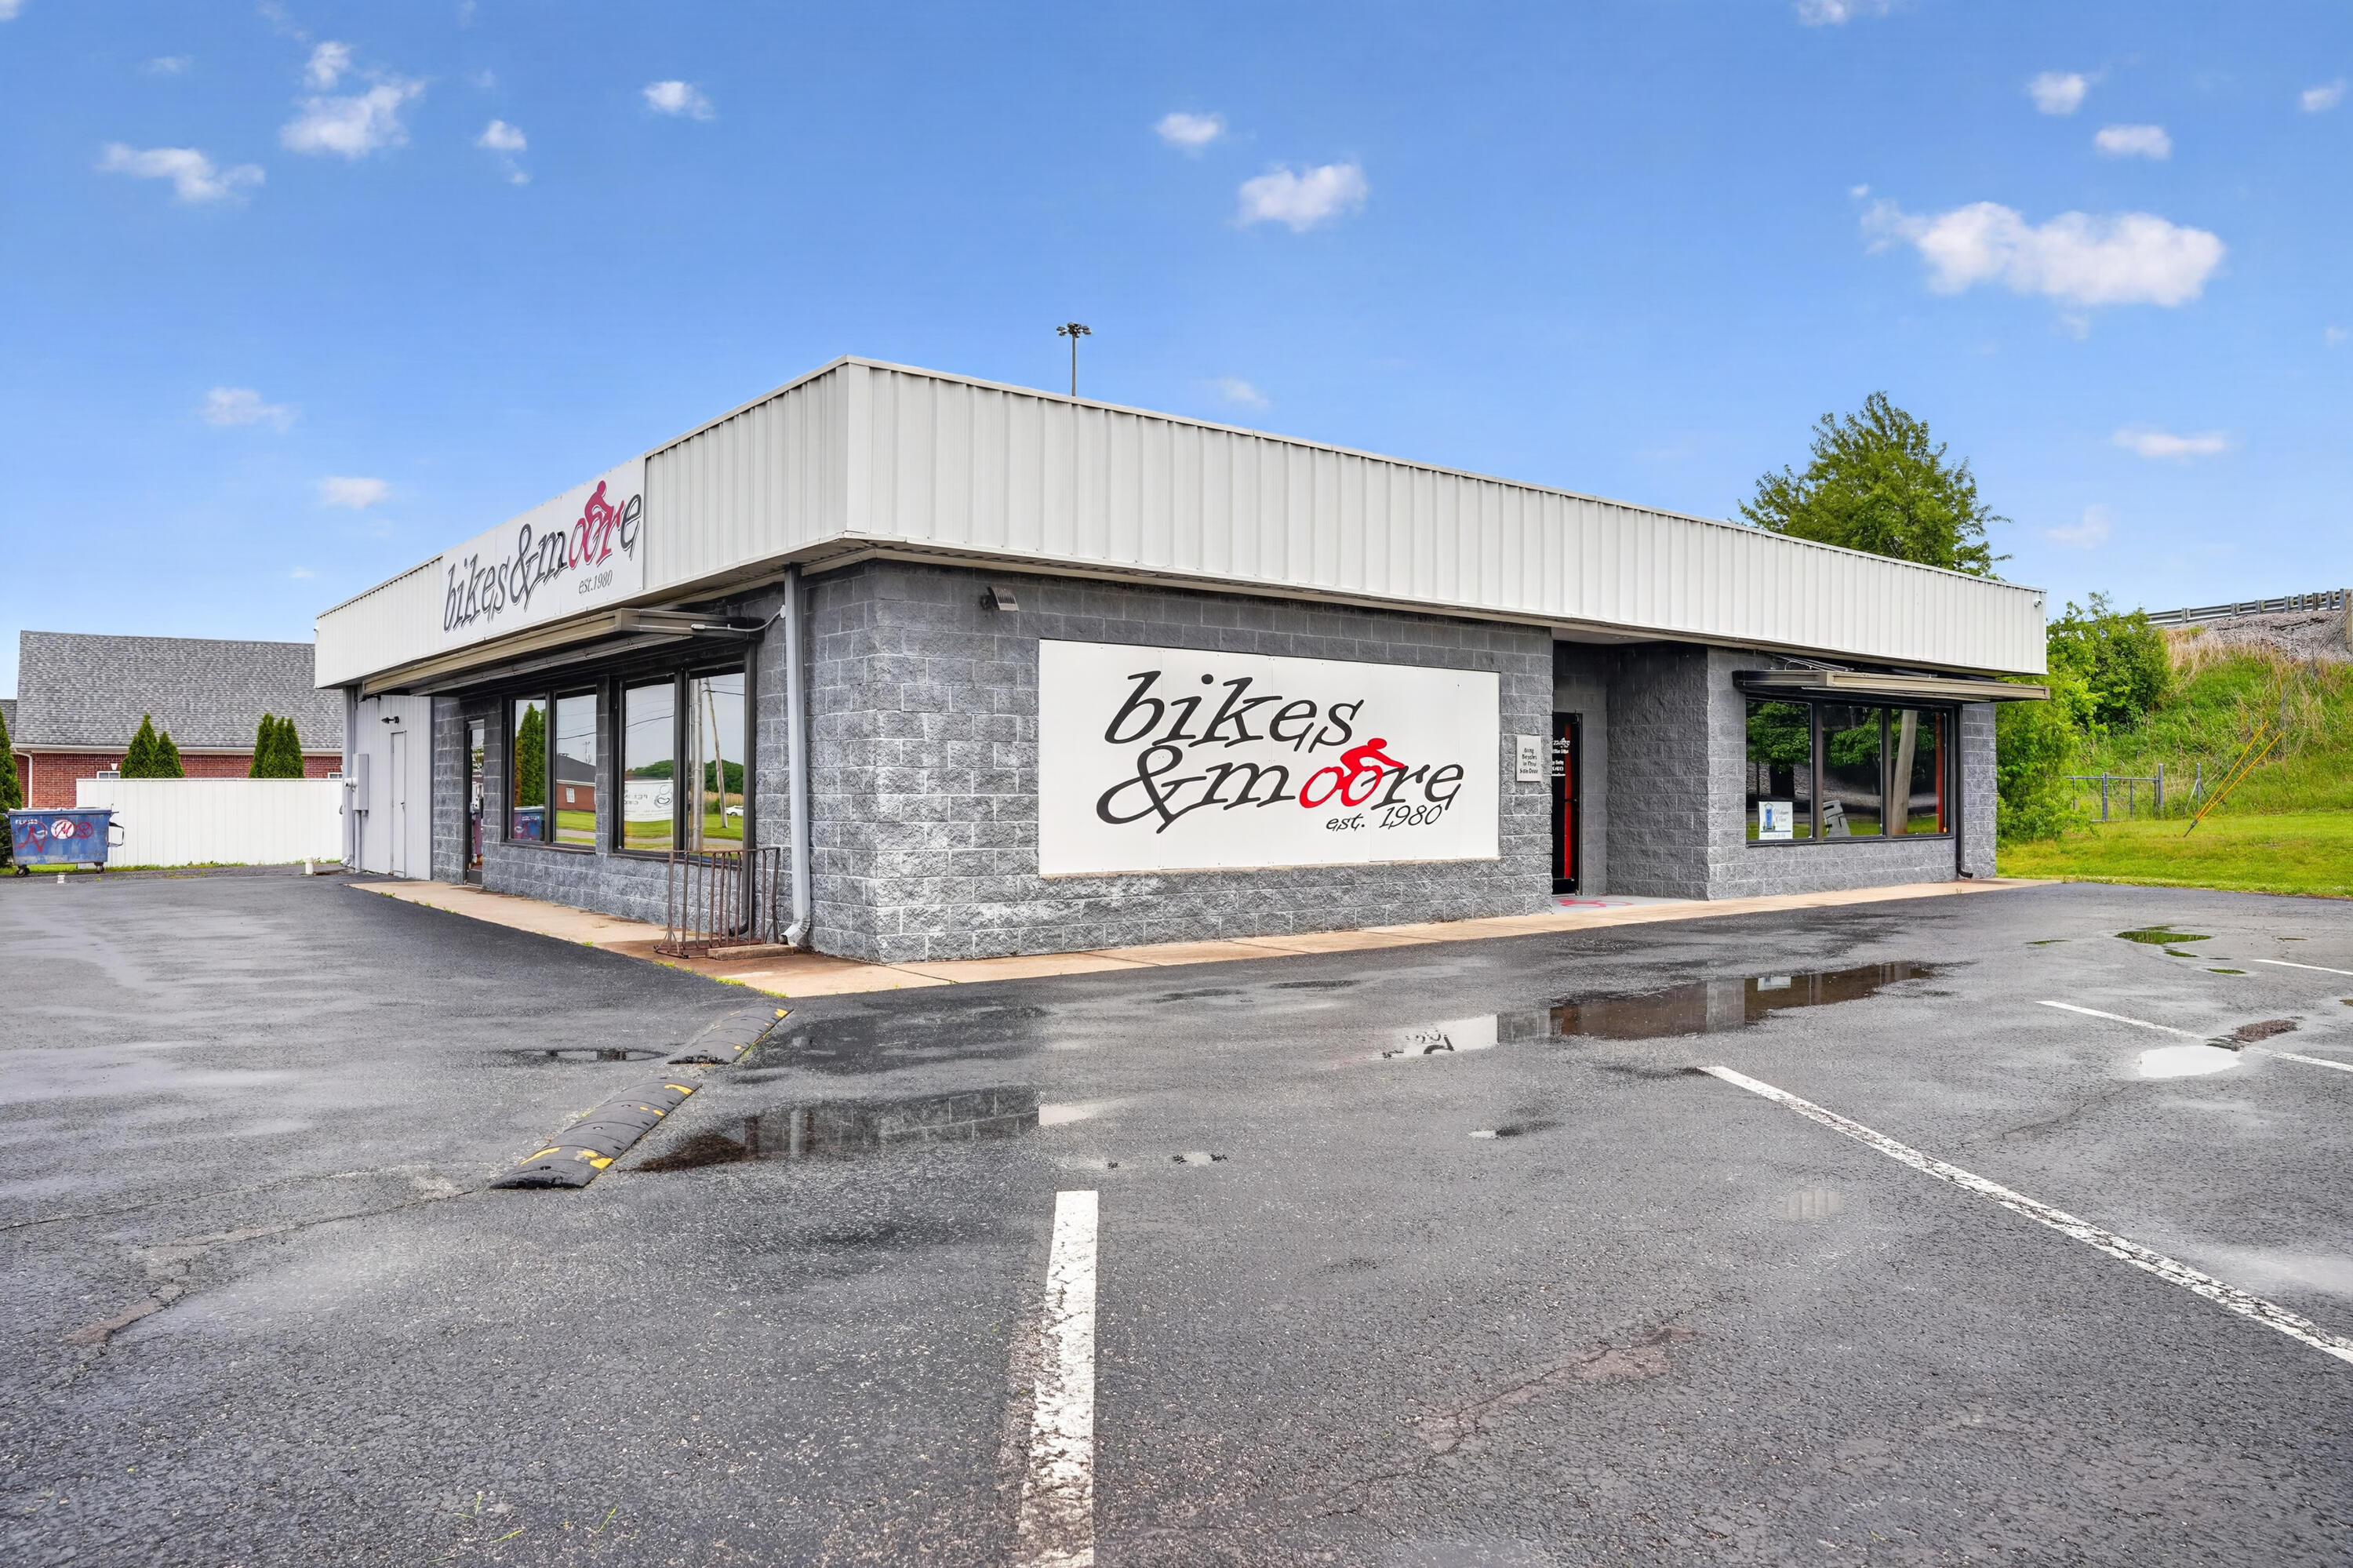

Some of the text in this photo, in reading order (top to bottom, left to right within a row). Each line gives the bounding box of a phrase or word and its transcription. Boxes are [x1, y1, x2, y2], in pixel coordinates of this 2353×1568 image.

[1104, 671, 1365, 753] bikes
[1326, 803, 1442, 831] est. 1980
